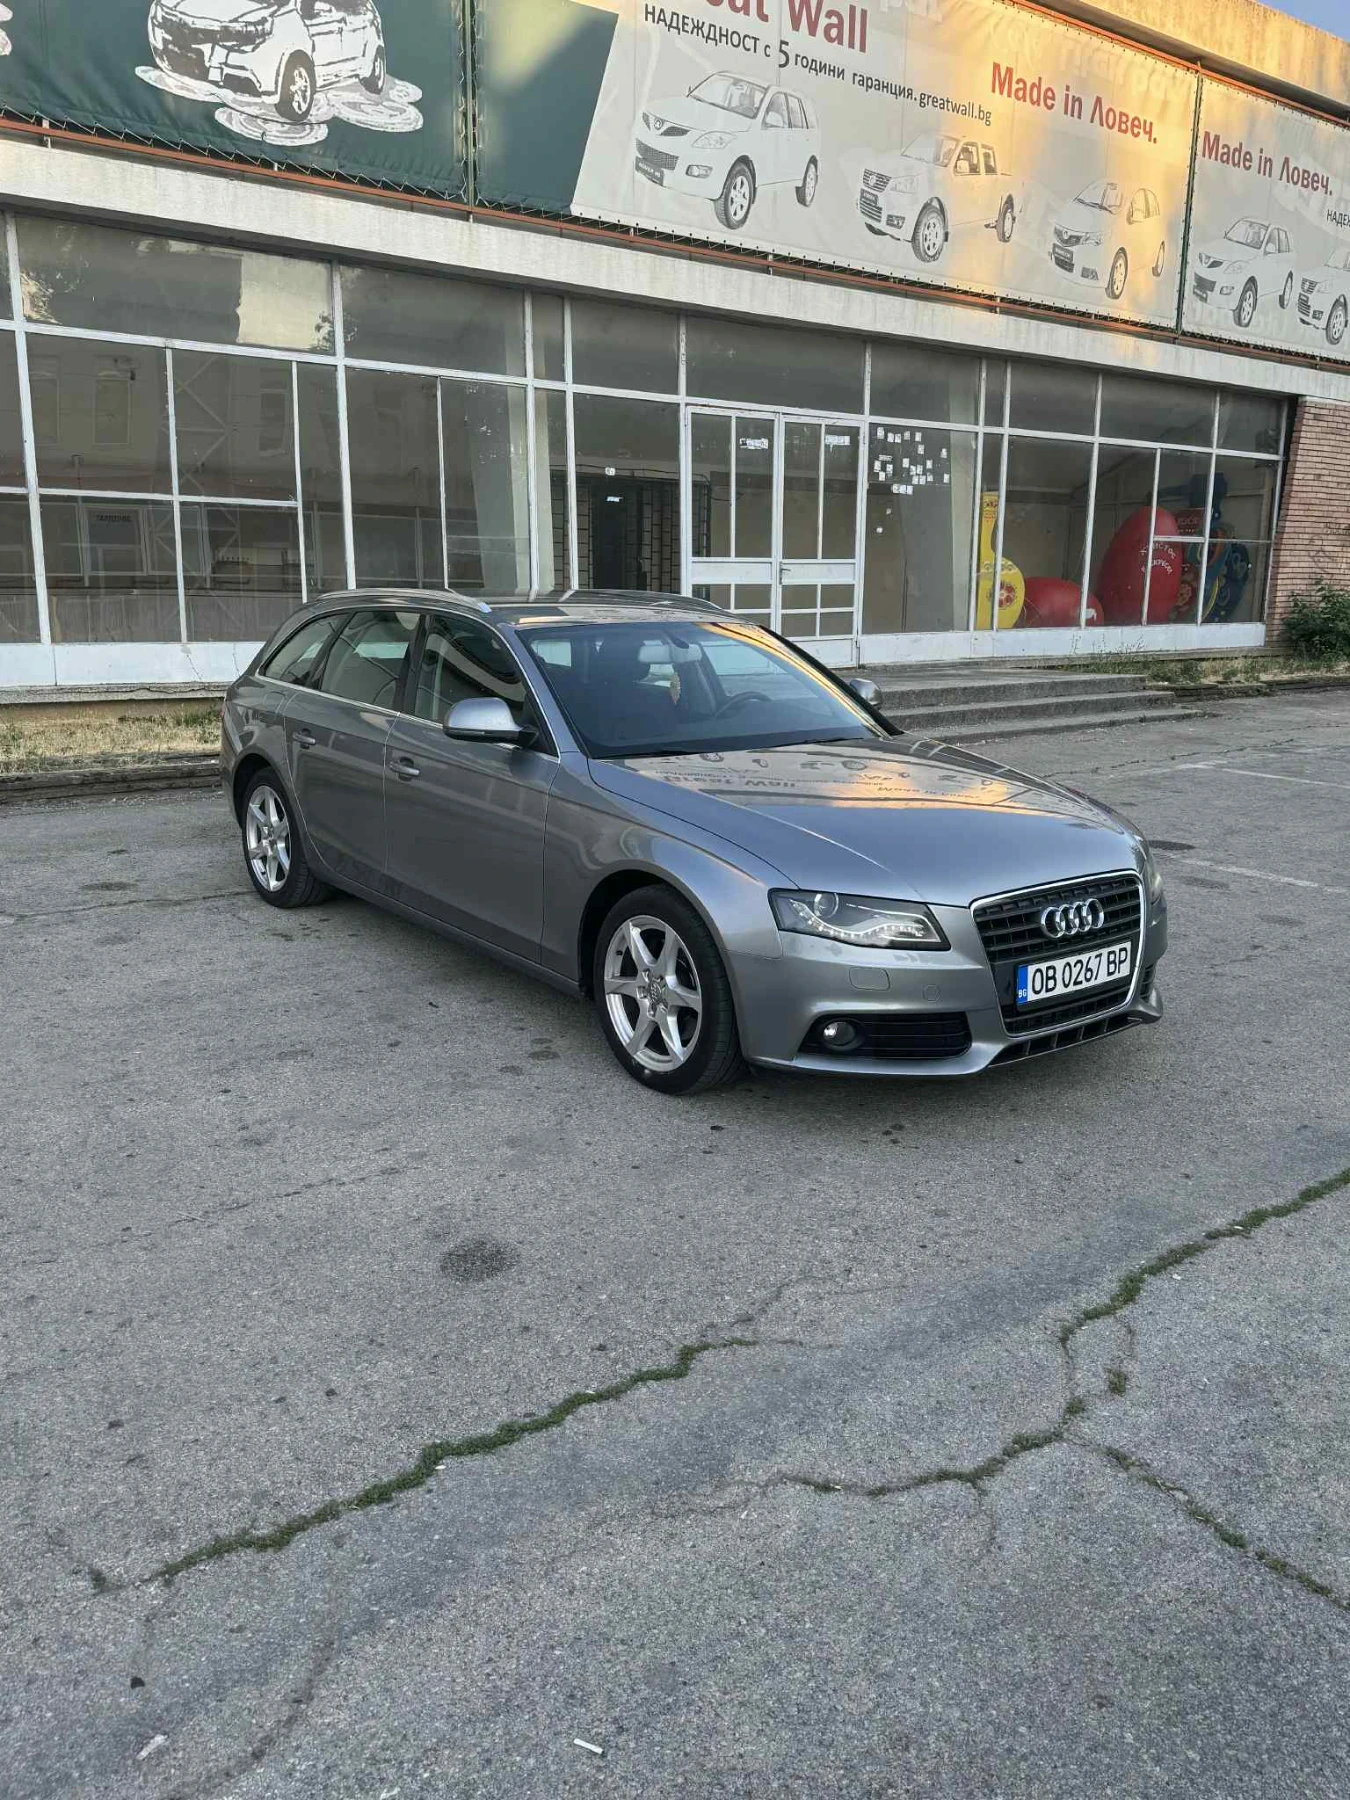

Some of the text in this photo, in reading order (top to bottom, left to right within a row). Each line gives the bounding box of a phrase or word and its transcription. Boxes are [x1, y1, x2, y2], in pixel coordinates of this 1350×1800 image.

[644, 5, 760, 54] НАДЕЖДНОСТ
[764, 42, 771, 58] с
[778, 40, 790, 68] 5
[794, 53, 845, 81] години
[788, 0, 868, 54] Wall
[991, 62, 1056, 111] Made
[1063, 85, 1083, 120] in
[1201, 130, 1253, 171] Made
[1257, 148, 1273, 178] in
[1018, 988, 1027, 998] BG
[1031, 947, 1128, 995] OB 0267 BP
